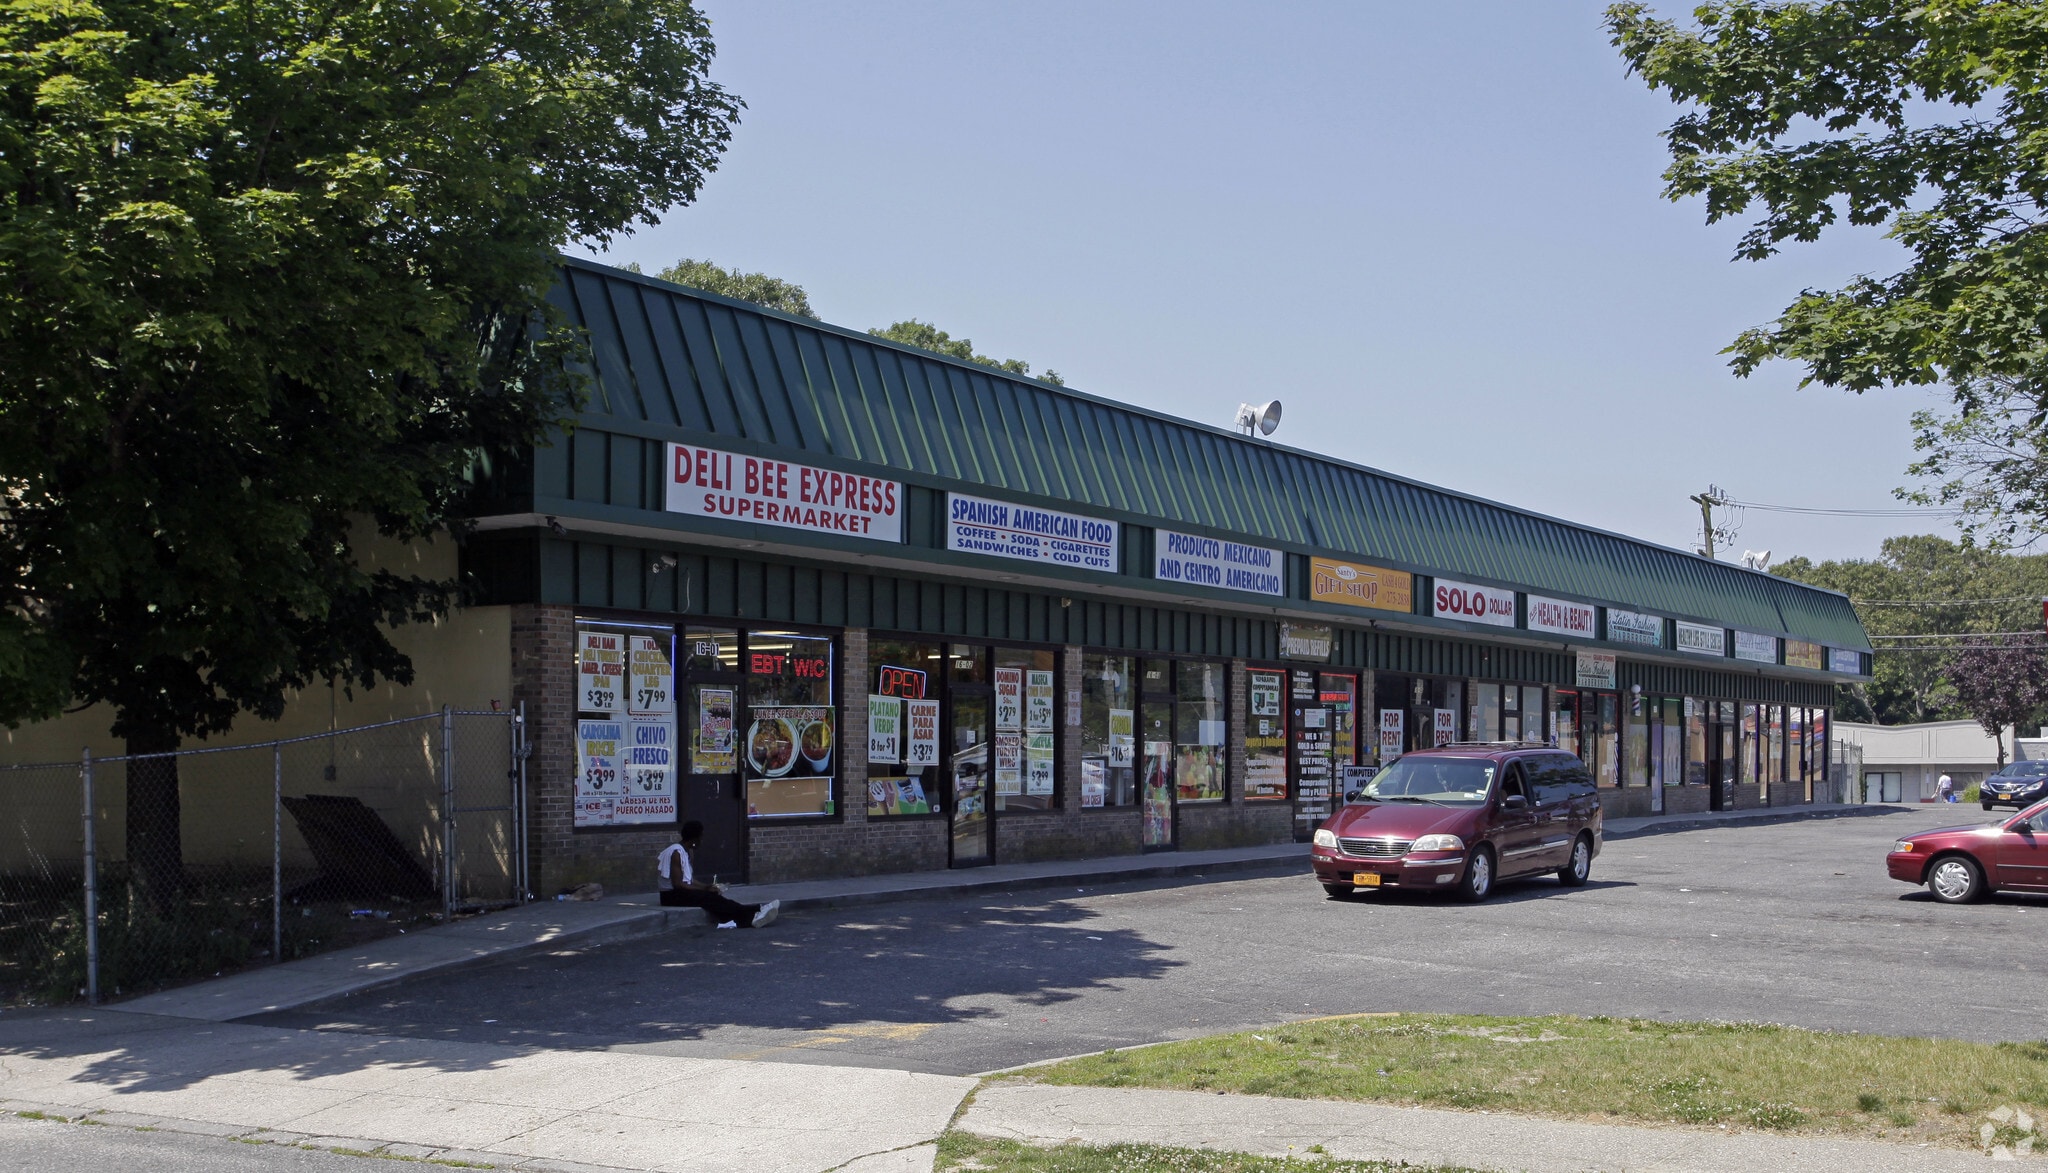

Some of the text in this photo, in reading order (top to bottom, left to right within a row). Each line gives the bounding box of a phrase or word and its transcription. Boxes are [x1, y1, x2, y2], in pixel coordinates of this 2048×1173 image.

[675, 446, 895, 516] DELI BEE EXPRESS
[703, 493, 871, 534] SUPERMARKET
[952, 499, 1112, 543] SPANISH AMERICAN FOOD
[957, 526, 1110, 557] COFFEE SODA CIGARETTES
[957, 538, 1110, 568] SANDWICHES COLD CUTS
[1168, 533, 1271, 568] PRODUCTO MEXICANO
[1160, 558, 1278, 593] AND CENTRO AMERICANO
[1337, 568, 1356, 578] Santy's
[1315, 572, 1378, 603] GIFT SHOP
[1436, 586, 1512, 617] SOLO DOLLAR
[1538, 602, 1592, 632] HEALTH & BEAUTY
[697, 642, 719, 656] 16-01
[752, 654, 825, 678] EBT WIC
[882, 669, 924, 699] OPEN
[997, 671, 1019, 683] DOMINO
[999, 684, 1017, 696] SUGAR
[870, 701, 898, 718] PLATANO
[911, 705, 936, 716] CARNE
[874, 718, 894, 734] VERDE
[913, 717, 934, 728] PARA
[1384, 713, 1399, 727] FOR
[1438, 713, 1451, 727] FOR
[581, 724, 621, 739] CAROLINA
[636, 726, 666, 744] CHIVO
[913, 728, 933, 740] ASAR
[1382, 731, 1401, 745] RENT
[1436, 730, 1453, 744] RENT
[587, 741, 615, 756] RICE
[871, 737, 895, 754] 8 for $1
[633, 748, 668, 765] FRESCO
[1347, 769, 1376, 777] COMPUTERS
[1356, 779, 1366, 788] AND
[616, 806, 674, 814] PUERCO HASADO
